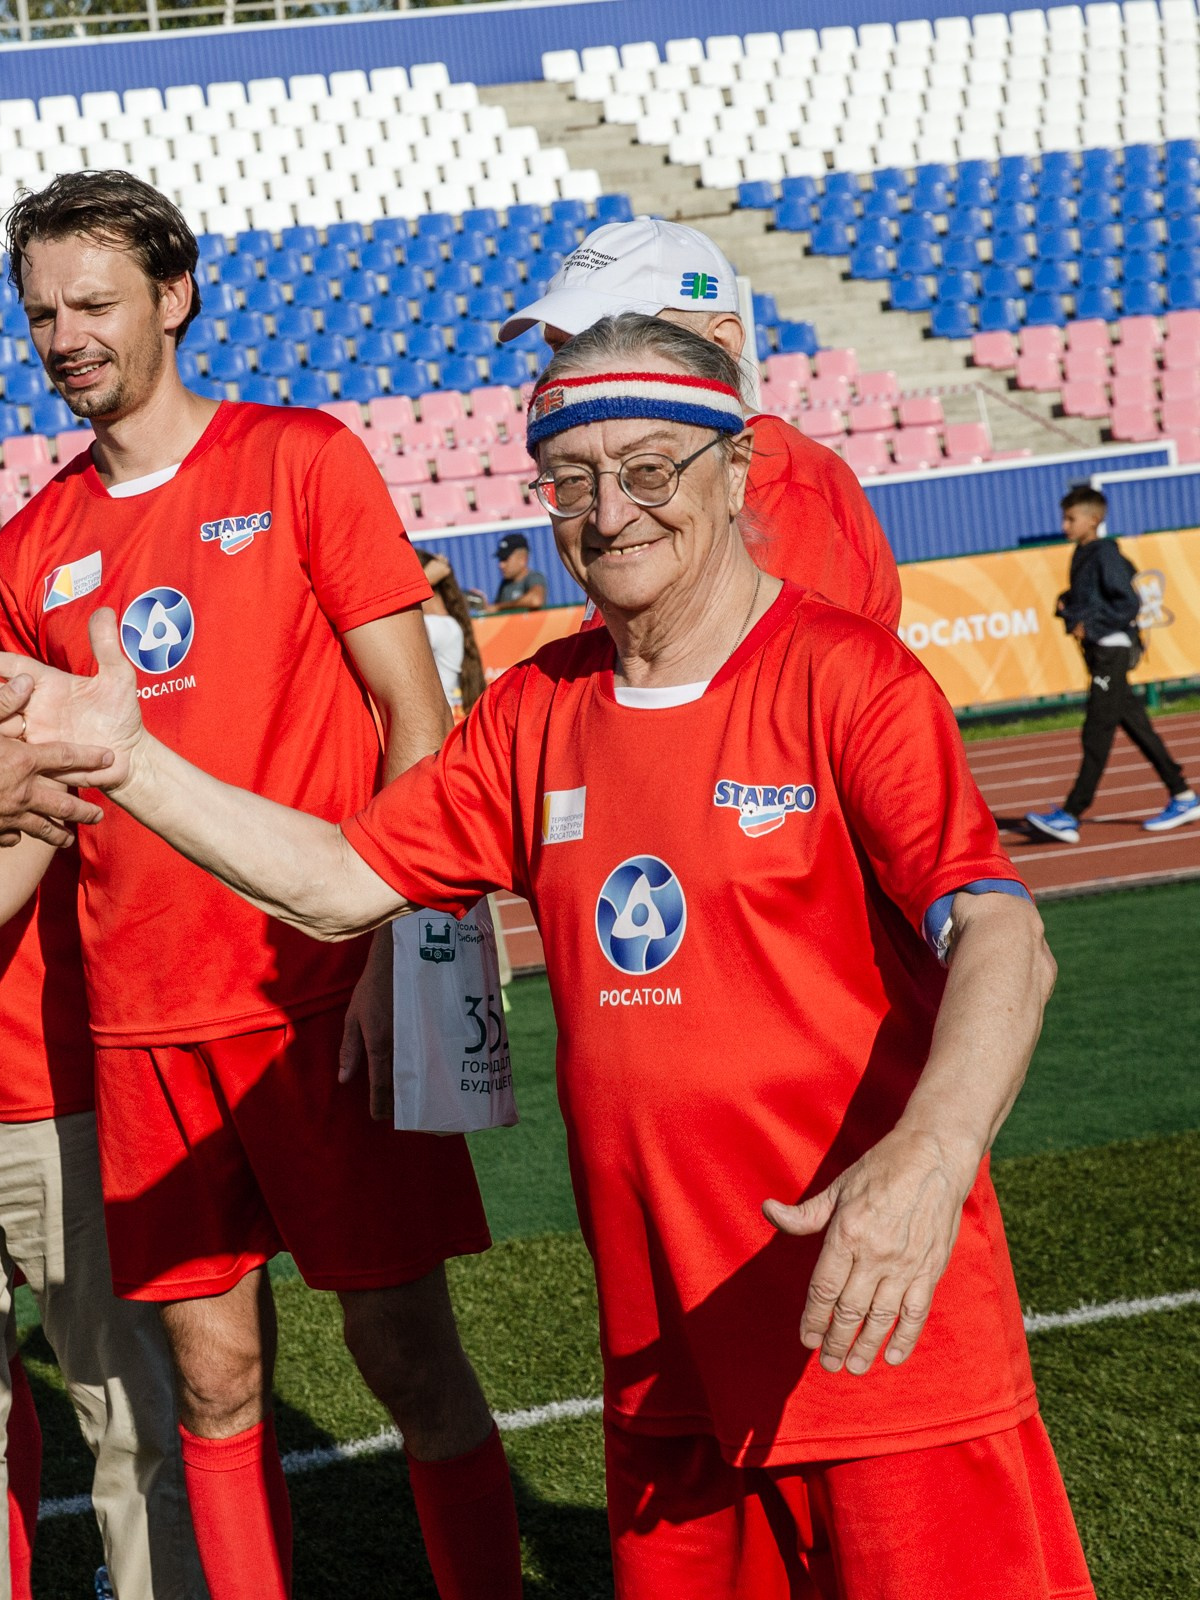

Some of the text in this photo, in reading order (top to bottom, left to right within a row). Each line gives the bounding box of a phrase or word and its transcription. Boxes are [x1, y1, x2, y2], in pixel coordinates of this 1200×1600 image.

[201, 511, 272, 541] STARCO
[898, 608, 1039, 650] ОСАТОМ
[714, 780, 816, 812] STARCO
[549, 829, 582, 840] РОСАТОМА
[600, 987, 682, 1007] РОСАТОМ
[464, 994, 509, 1055] 35
